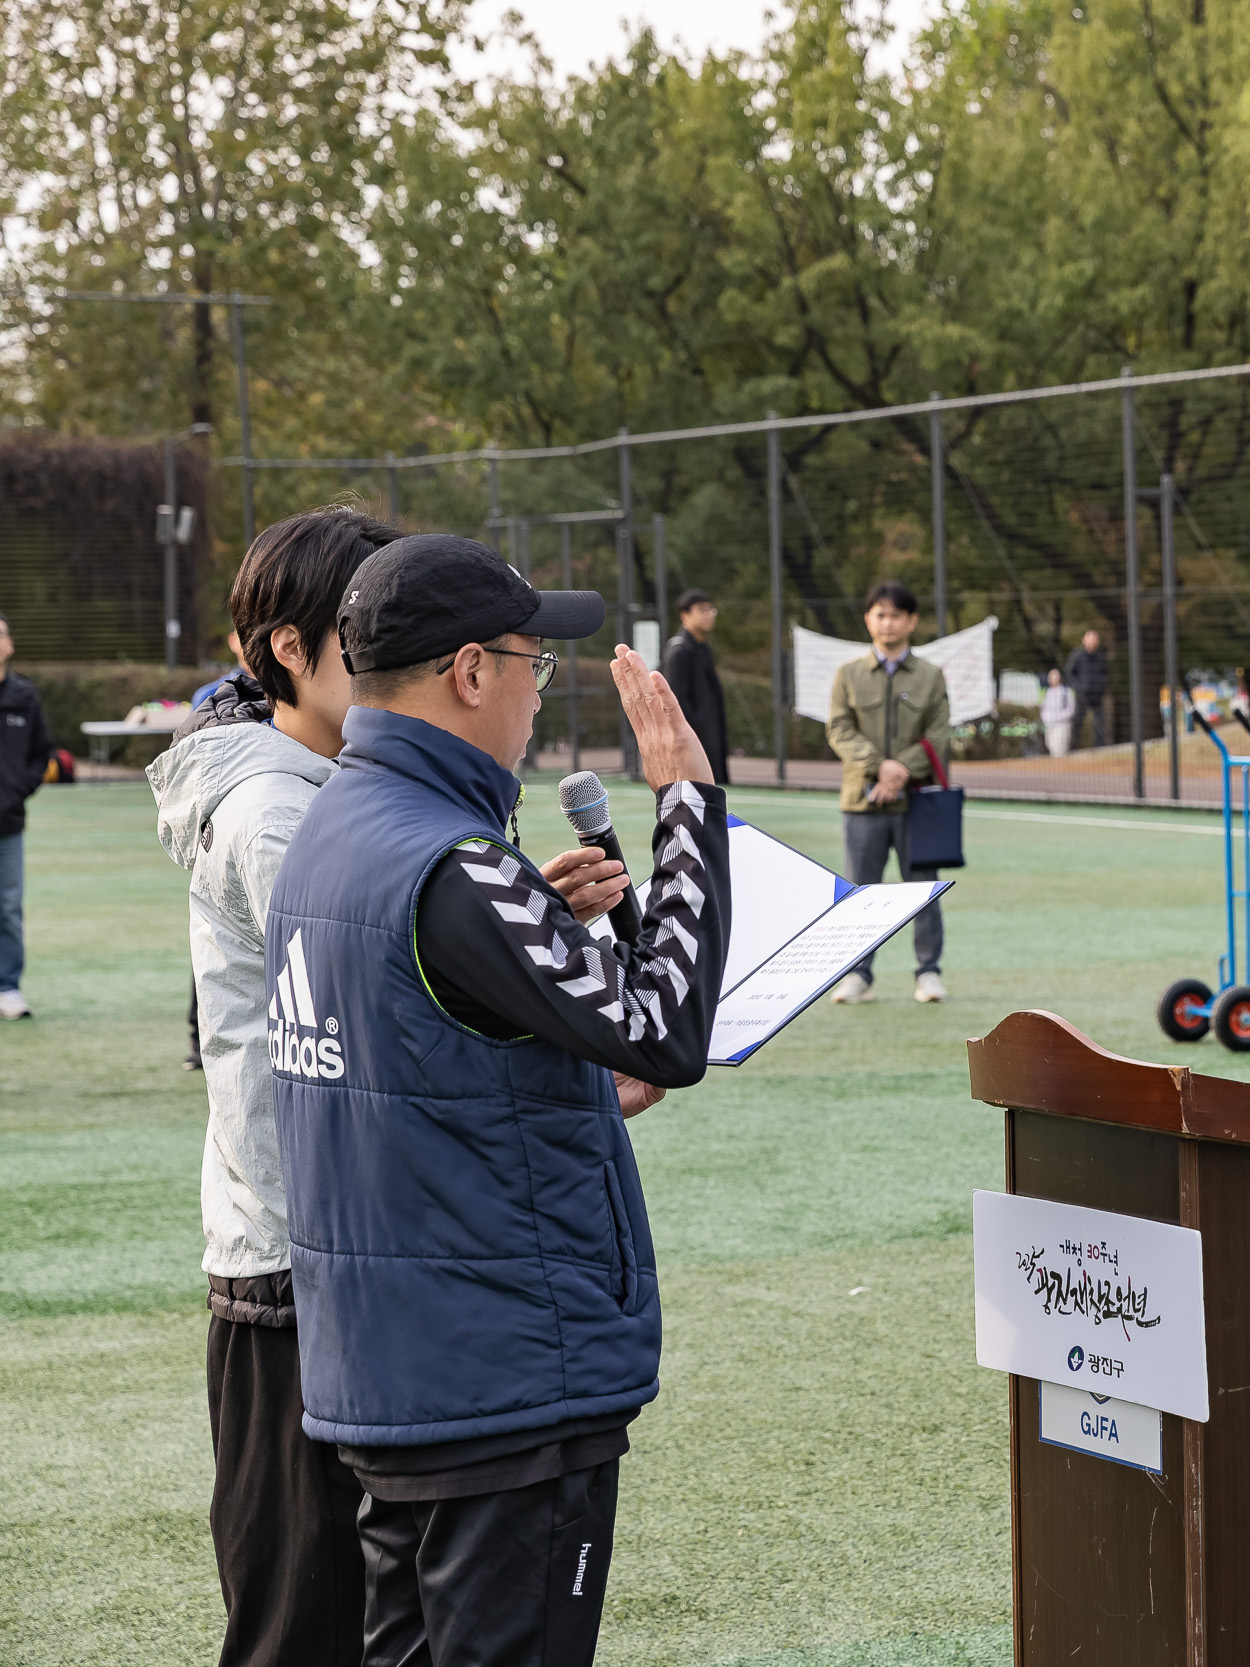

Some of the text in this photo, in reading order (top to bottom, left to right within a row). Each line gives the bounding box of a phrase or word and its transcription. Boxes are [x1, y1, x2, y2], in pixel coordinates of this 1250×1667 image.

[1015, 1245, 1045, 1284] 2025
[1059, 1239, 1119, 1277] 개청 30주년
[1087, 1353, 1125, 1379] 광진구
[1080, 1410, 1120, 1444] GJFA
[572, 1543, 592, 1596] hummel
